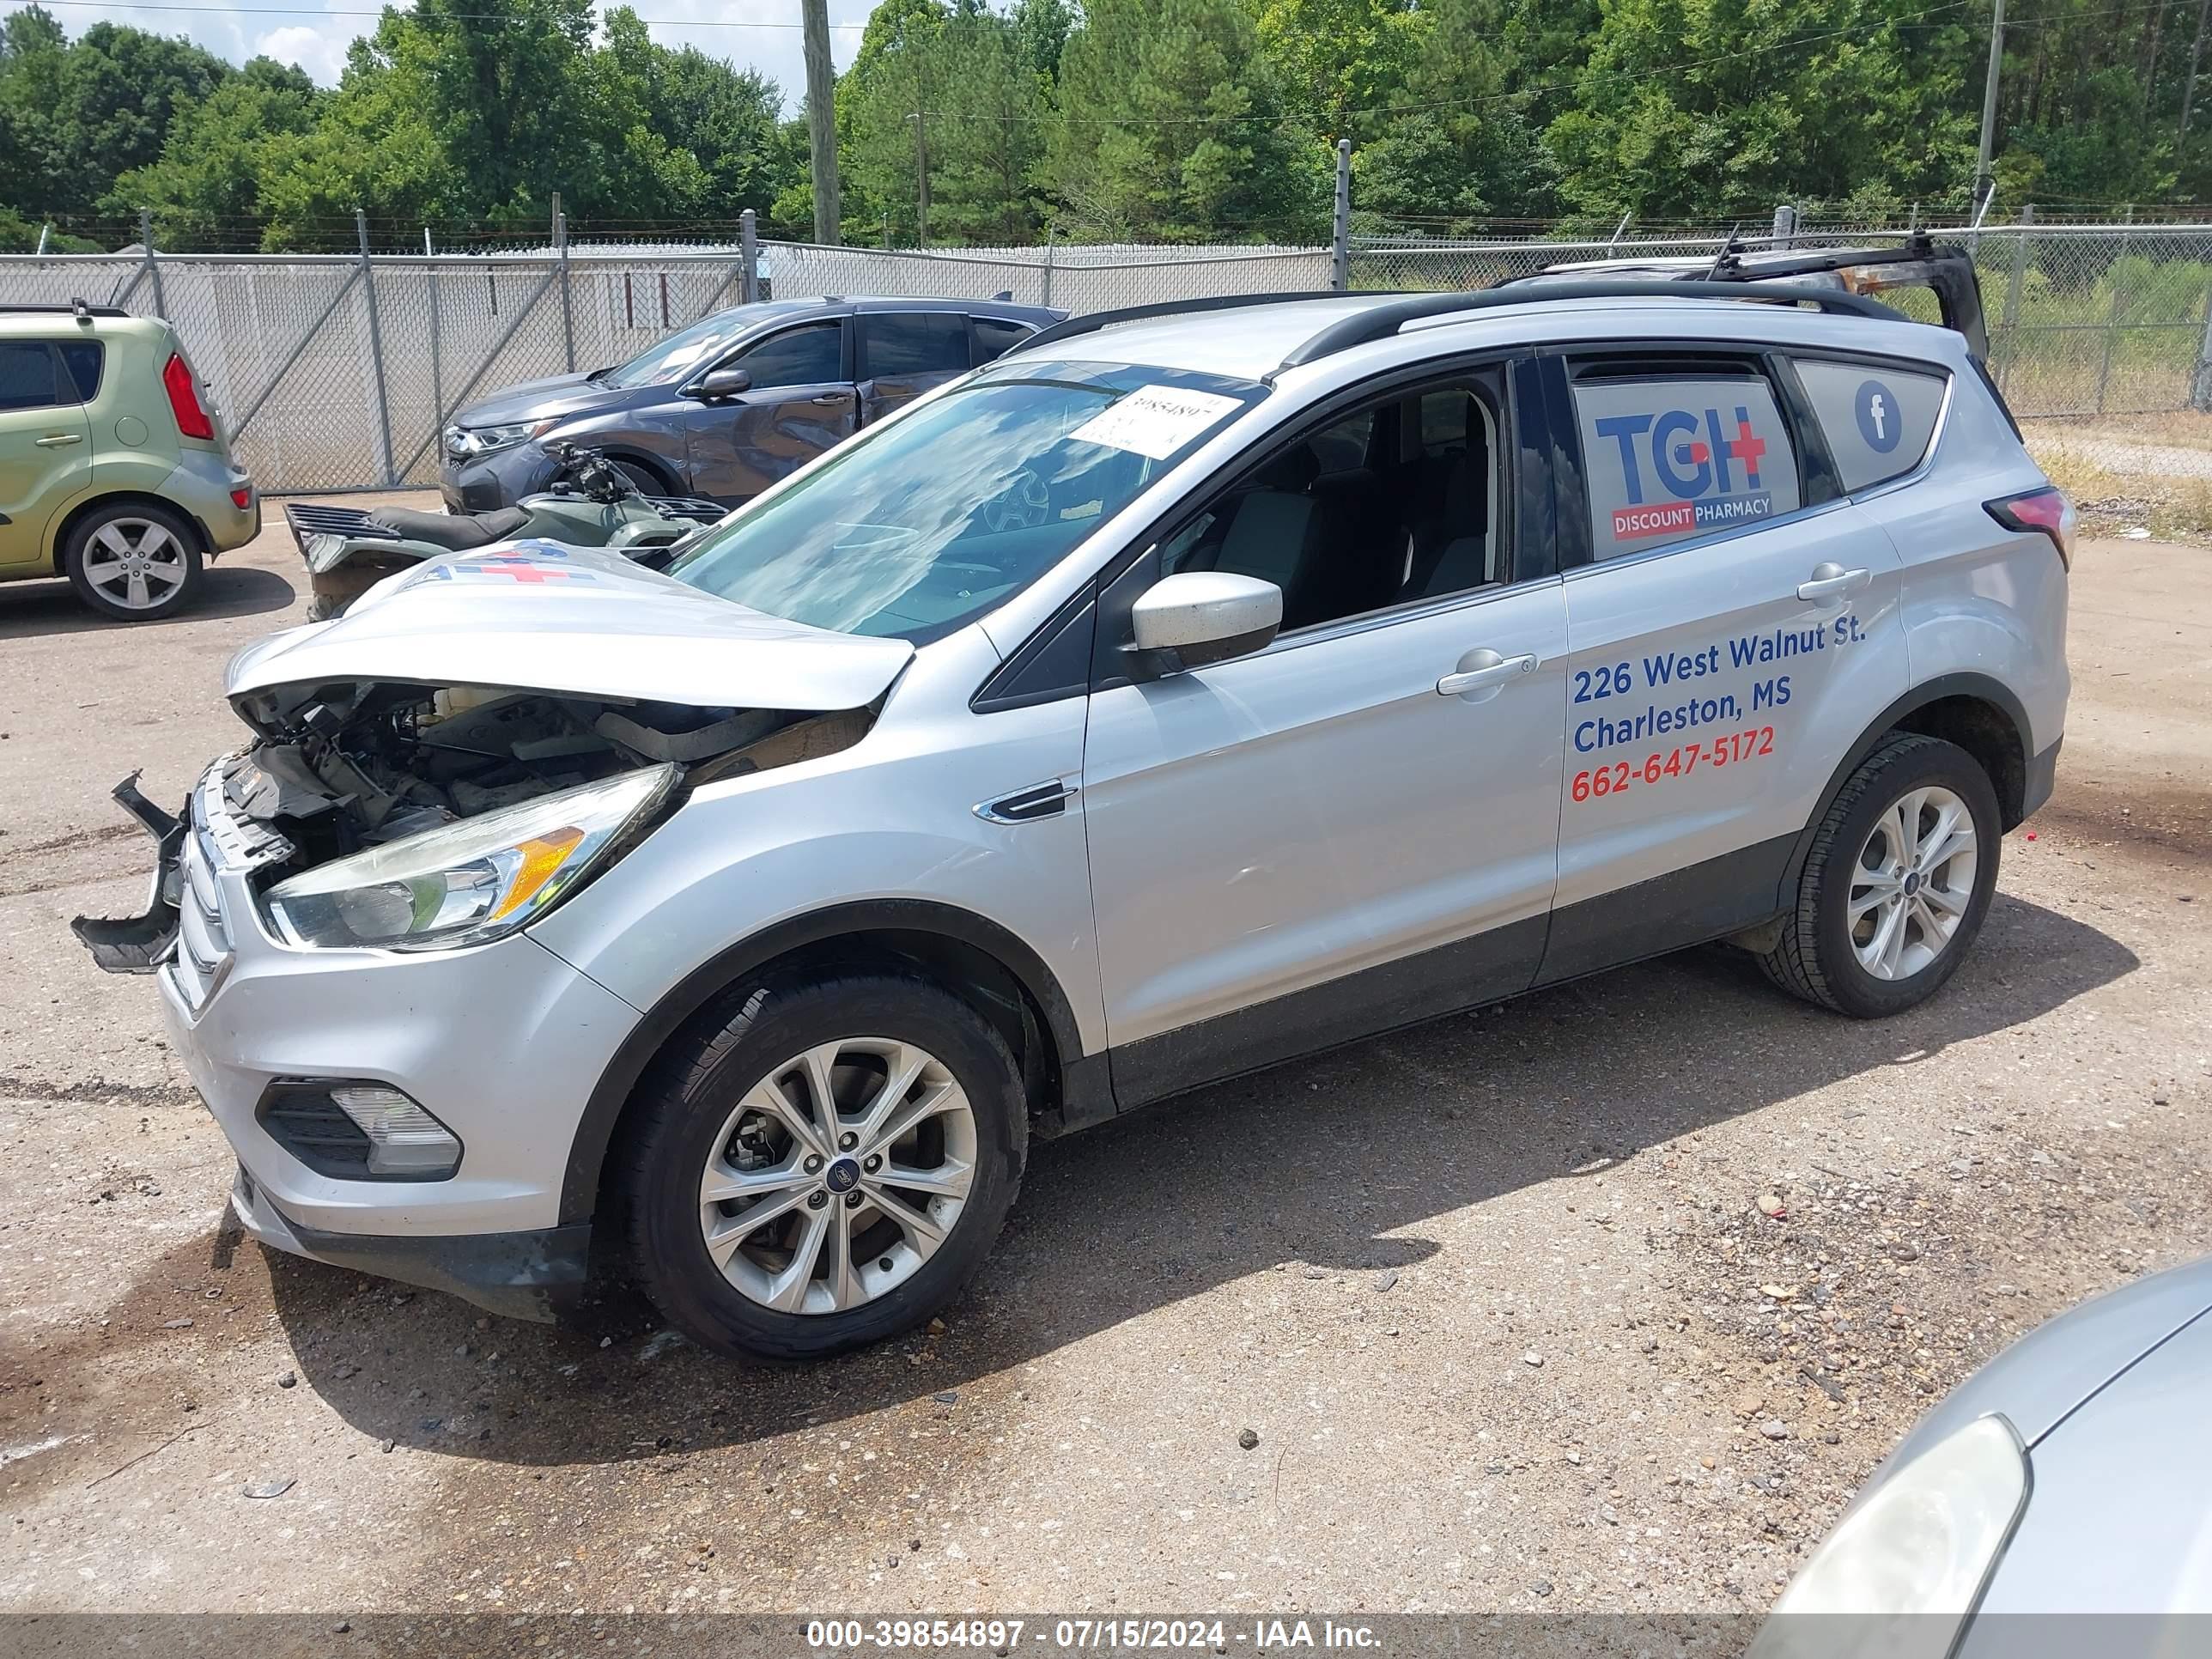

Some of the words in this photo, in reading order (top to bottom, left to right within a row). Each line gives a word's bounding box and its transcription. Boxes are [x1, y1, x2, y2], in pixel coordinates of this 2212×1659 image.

[1595, 406, 1766, 504] TGH
[1615, 508, 1692, 533] DISCOUNT
[1695, 497, 1771, 522] PHARMACY
[1573, 662, 1632, 703] 226
[1643, 646, 1719, 687] West
[1729, 623, 1826, 668] Walnut
[1833, 615, 1867, 647] St.
[1573, 694, 1743, 752] Charleston,
[1753, 675, 1791, 711] MS
[1571, 726, 1775, 803] 662-647-5172
